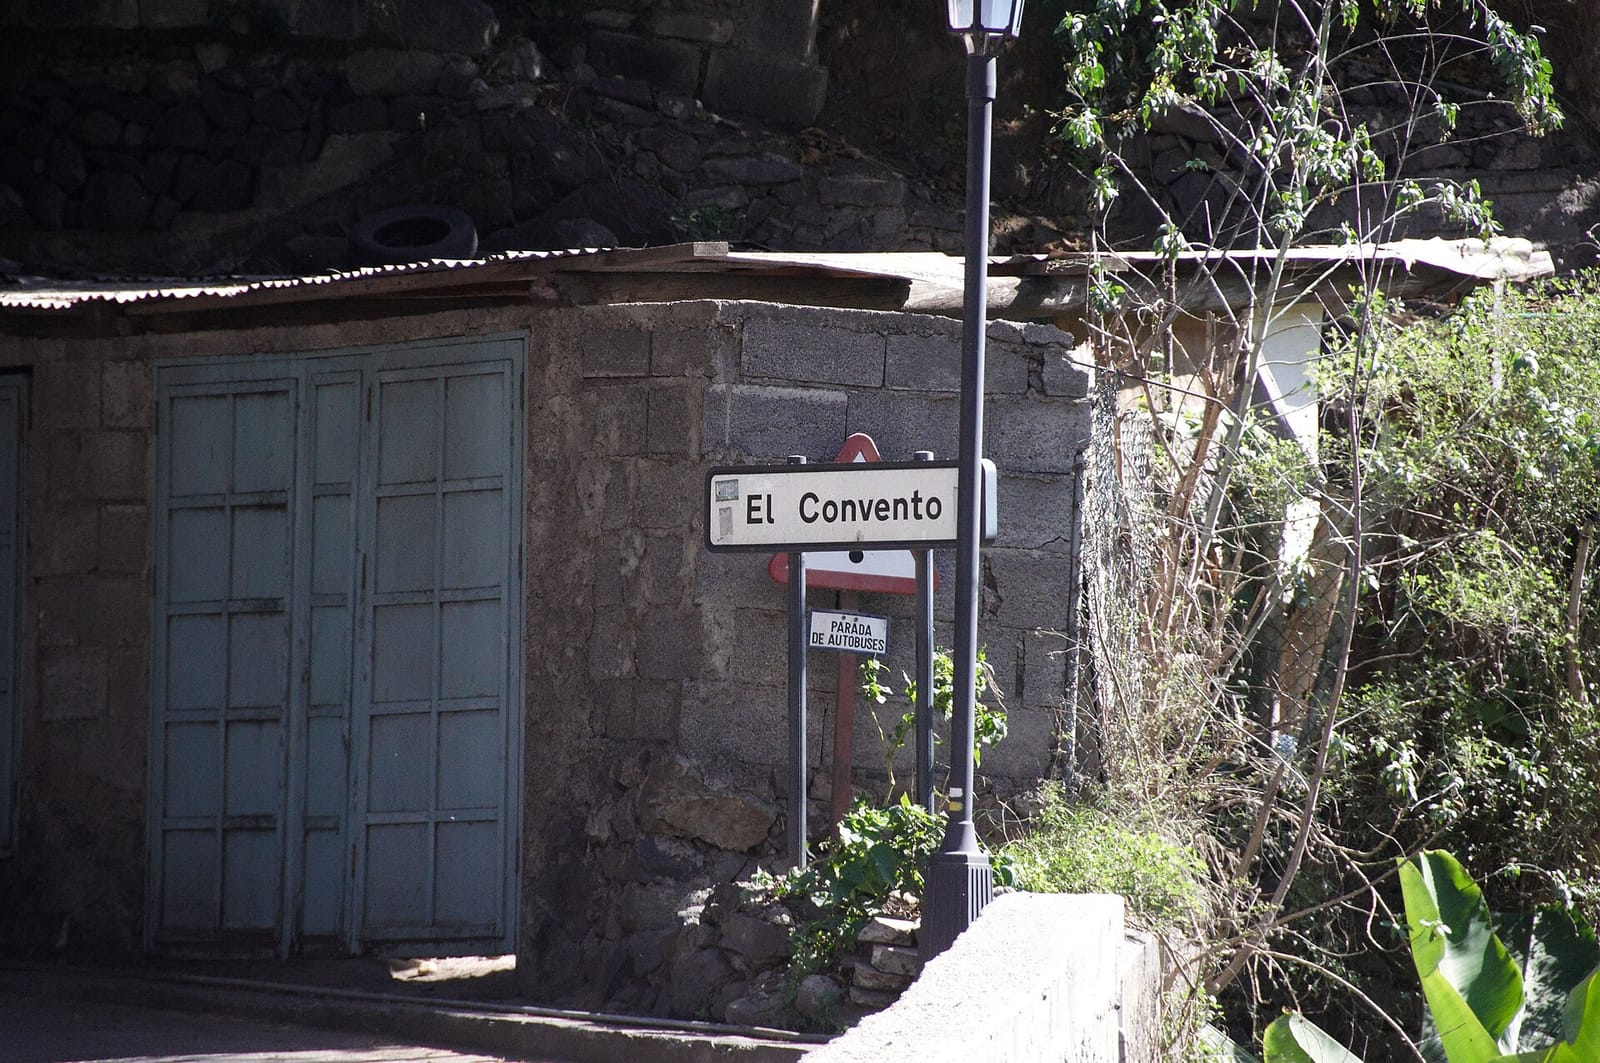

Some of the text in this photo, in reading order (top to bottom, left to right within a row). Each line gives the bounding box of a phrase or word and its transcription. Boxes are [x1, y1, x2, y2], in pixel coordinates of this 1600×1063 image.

[746, 489, 942, 525] El Convento
[830, 620, 872, 637] PARADA
[811, 631, 885, 652] DE AUTOBUSES
